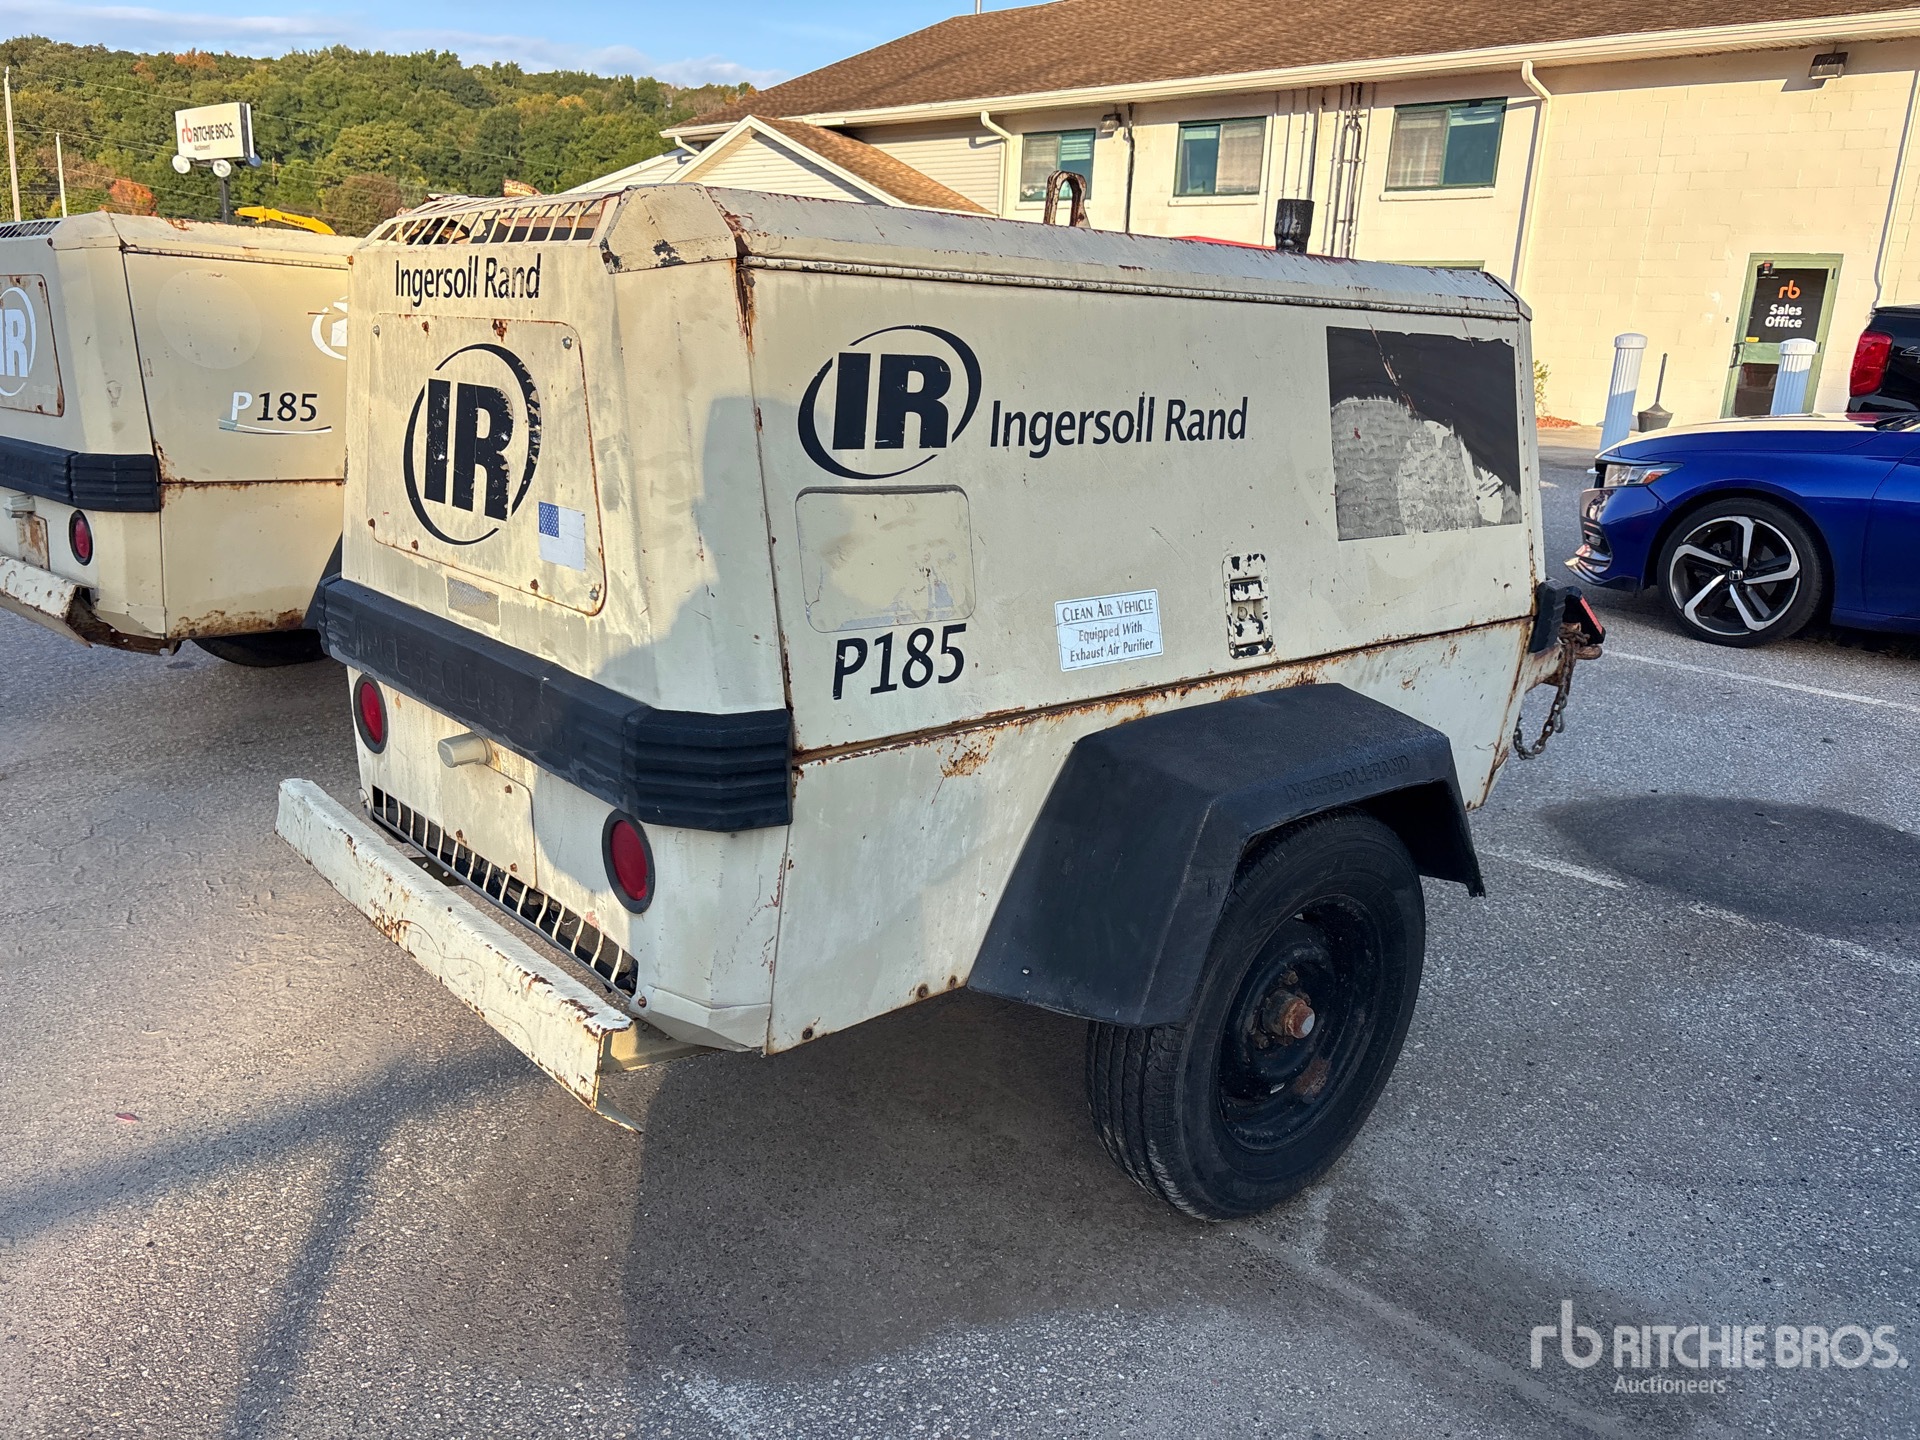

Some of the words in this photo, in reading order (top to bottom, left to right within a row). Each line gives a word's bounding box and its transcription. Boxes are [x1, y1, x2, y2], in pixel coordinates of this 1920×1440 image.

[395, 255, 479, 307] Ingersoll
[485, 253, 541, 299] Rand
[1778, 280, 1800, 299] rb
[1765, 316, 1803, 328] Office
[1769, 304, 1803, 316] Sales
[832, 352, 952, 450] IR
[990, 396, 1156, 459] Ingersoll
[1165, 396, 1248, 442] Rand
[424, 378, 514, 521] IR
[1070, 647, 1104, 662] Exhaust
[1107, 643, 1119, 656] Air
[1123, 638, 1153, 653] Purifier
[1079, 623, 1119, 644] Equipped
[1122, 621, 1143, 635] With
[832, 623, 968, 701] P185
